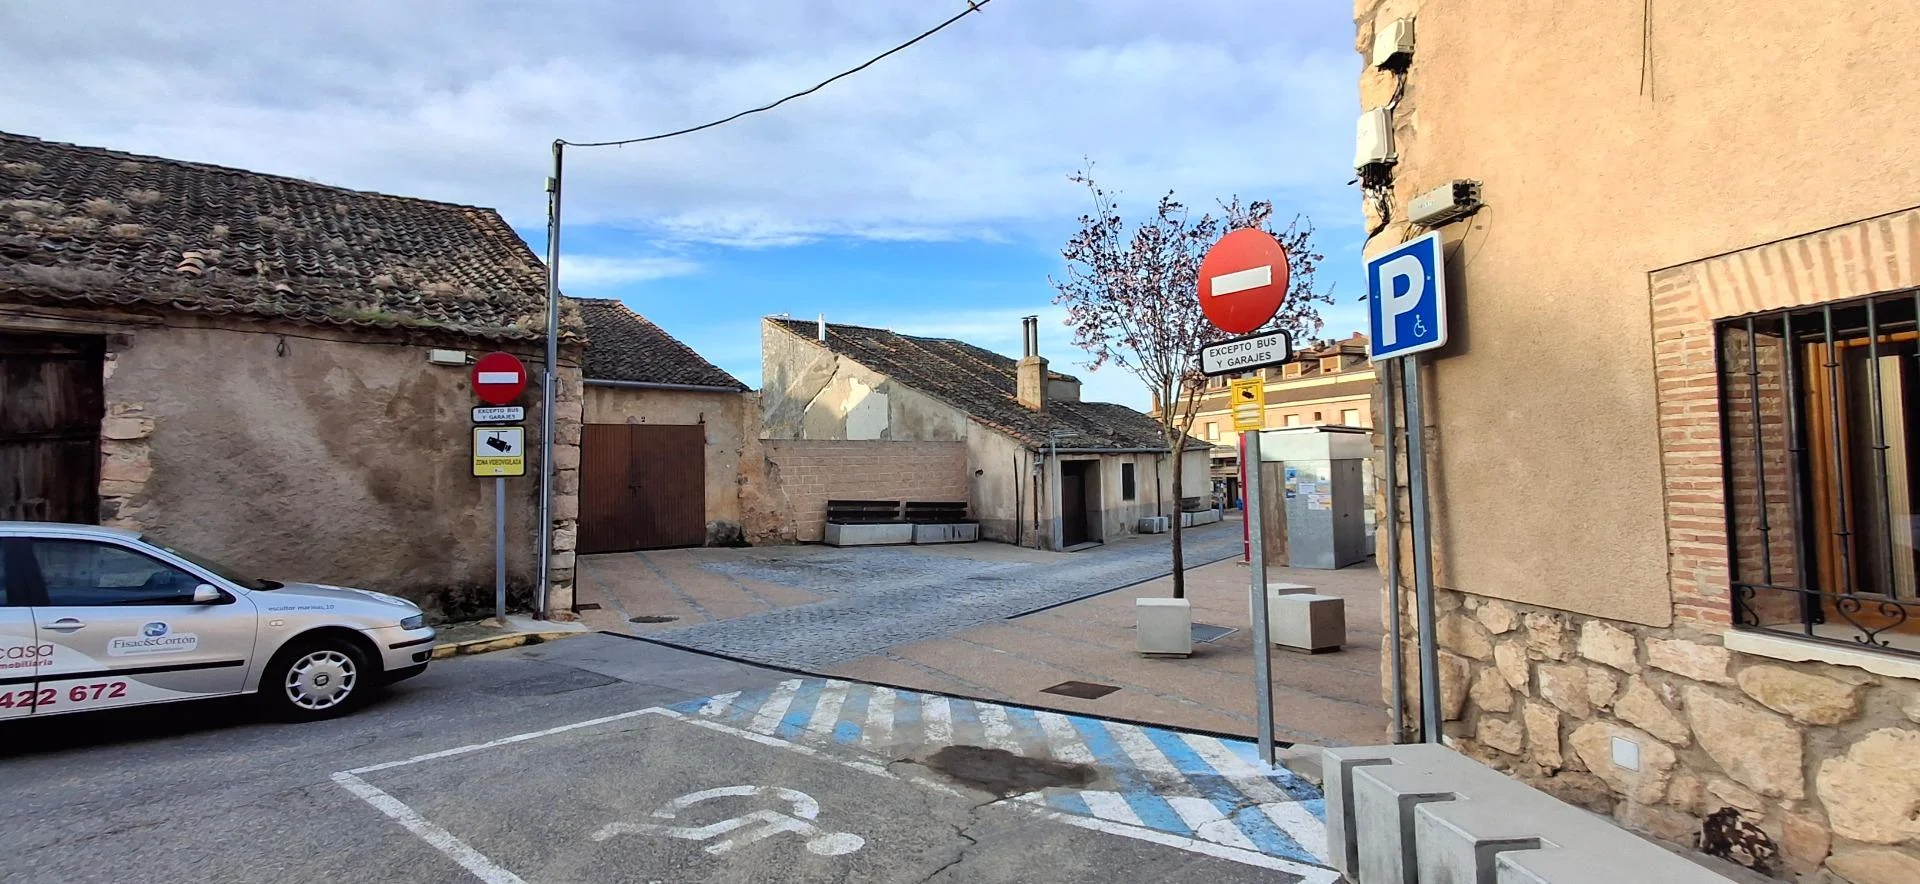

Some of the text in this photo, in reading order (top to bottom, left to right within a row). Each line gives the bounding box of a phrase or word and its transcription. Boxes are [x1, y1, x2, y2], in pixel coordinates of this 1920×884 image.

[1378, 254, 1425, 347] P
[1209, 337, 1277, 358] EXCEPTO BUS
[1216, 351, 1272, 368] Y GARAJES
[0, 682, 127, 708] 422 672
